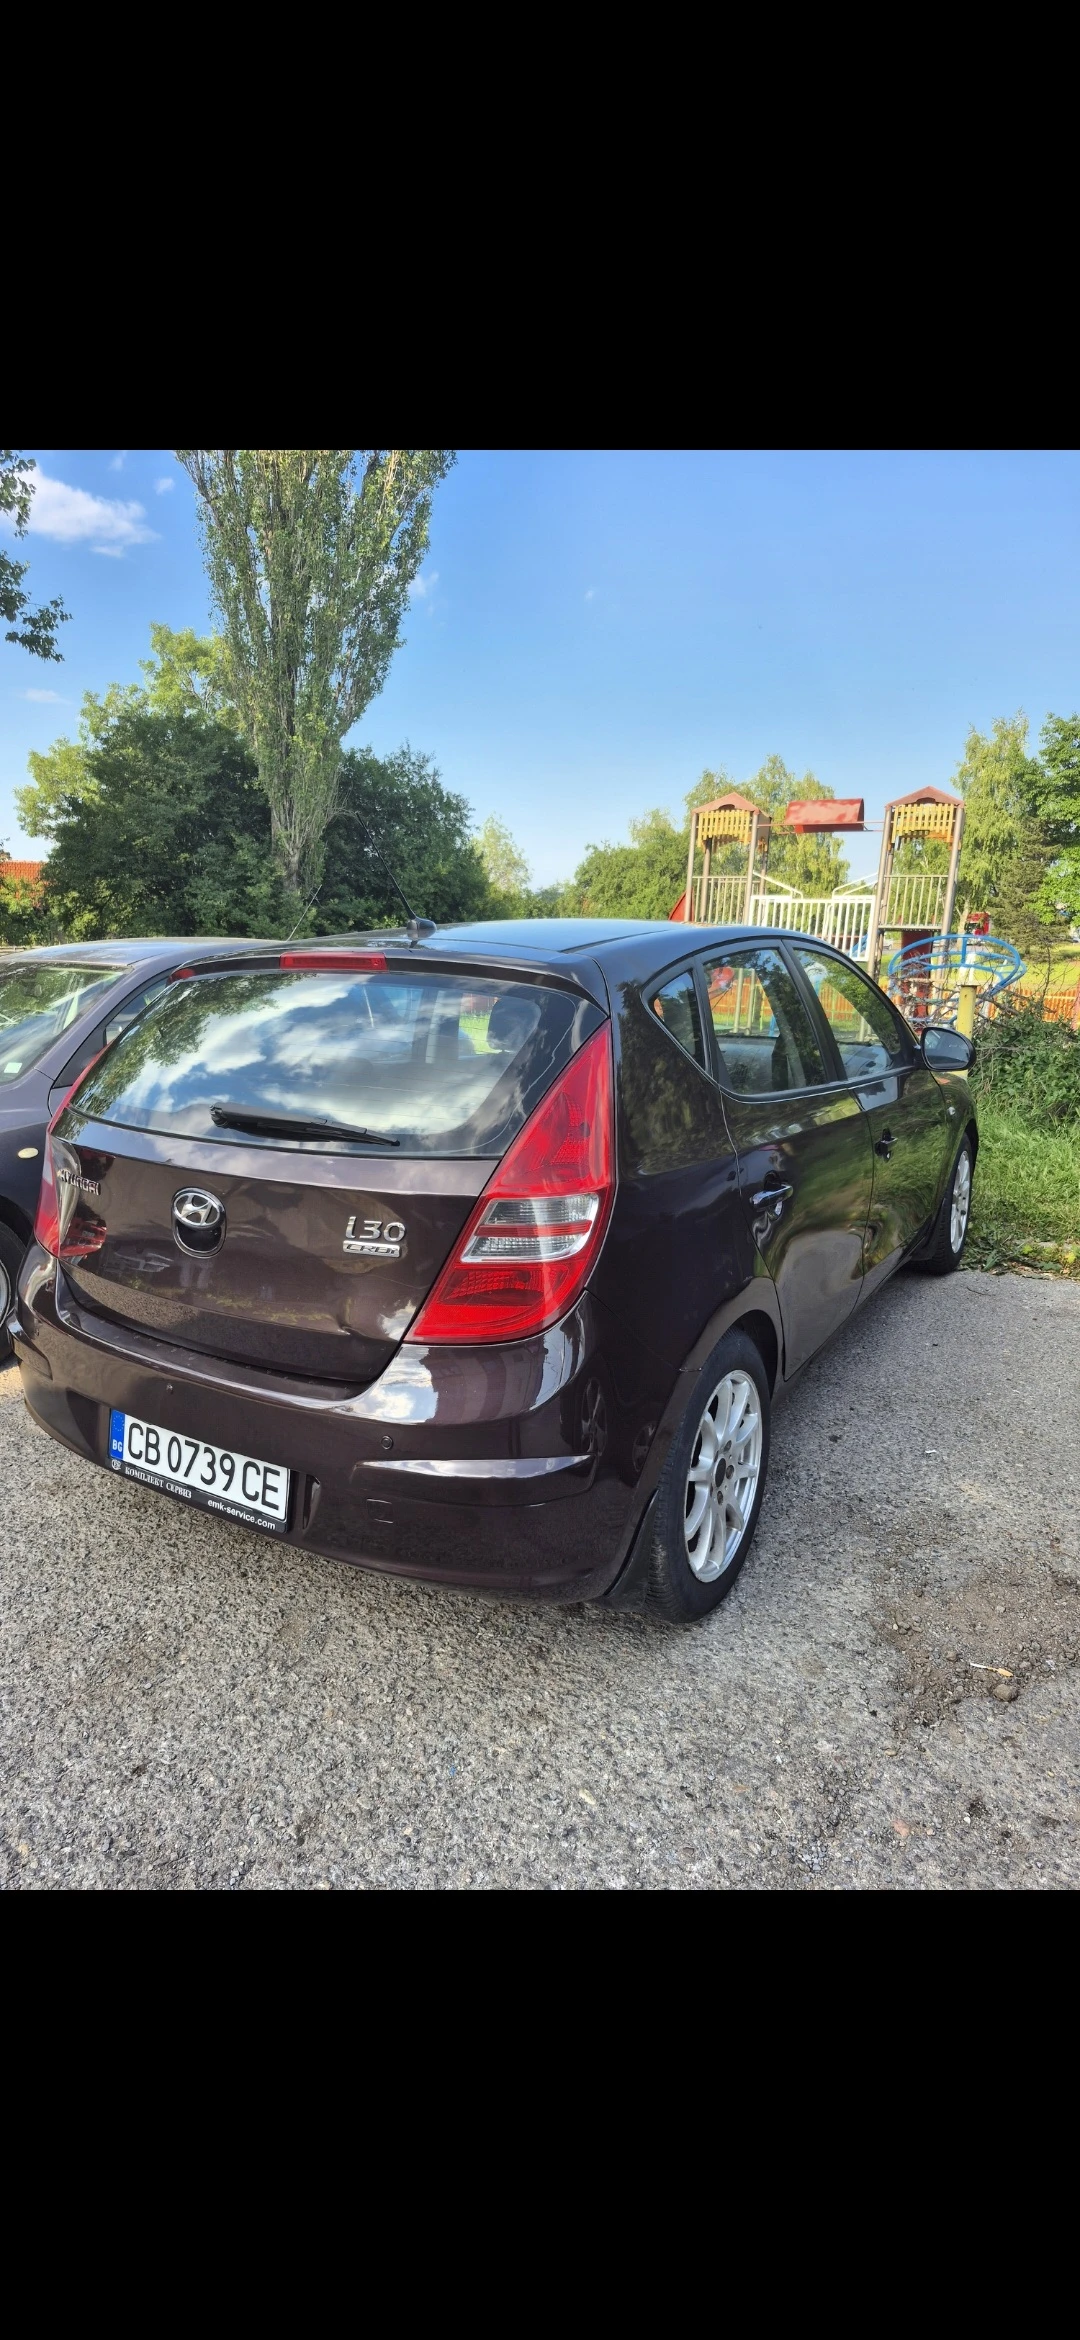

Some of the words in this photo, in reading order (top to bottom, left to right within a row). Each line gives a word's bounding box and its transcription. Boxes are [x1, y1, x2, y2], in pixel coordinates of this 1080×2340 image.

[345, 1215, 406, 1242] i30
[112, 1438, 123, 1453] BG
[127, 1422, 161, 1466] CB
[167, 1435, 236, 1492] 0739
[241, 1460, 281, 1511] CE
[124, 1466, 165, 1488] КОМПЛЕКТ
[165, 1482, 192, 1499] СЕРВИЗ
[207, 1499, 276, 1530] emk-service.com
